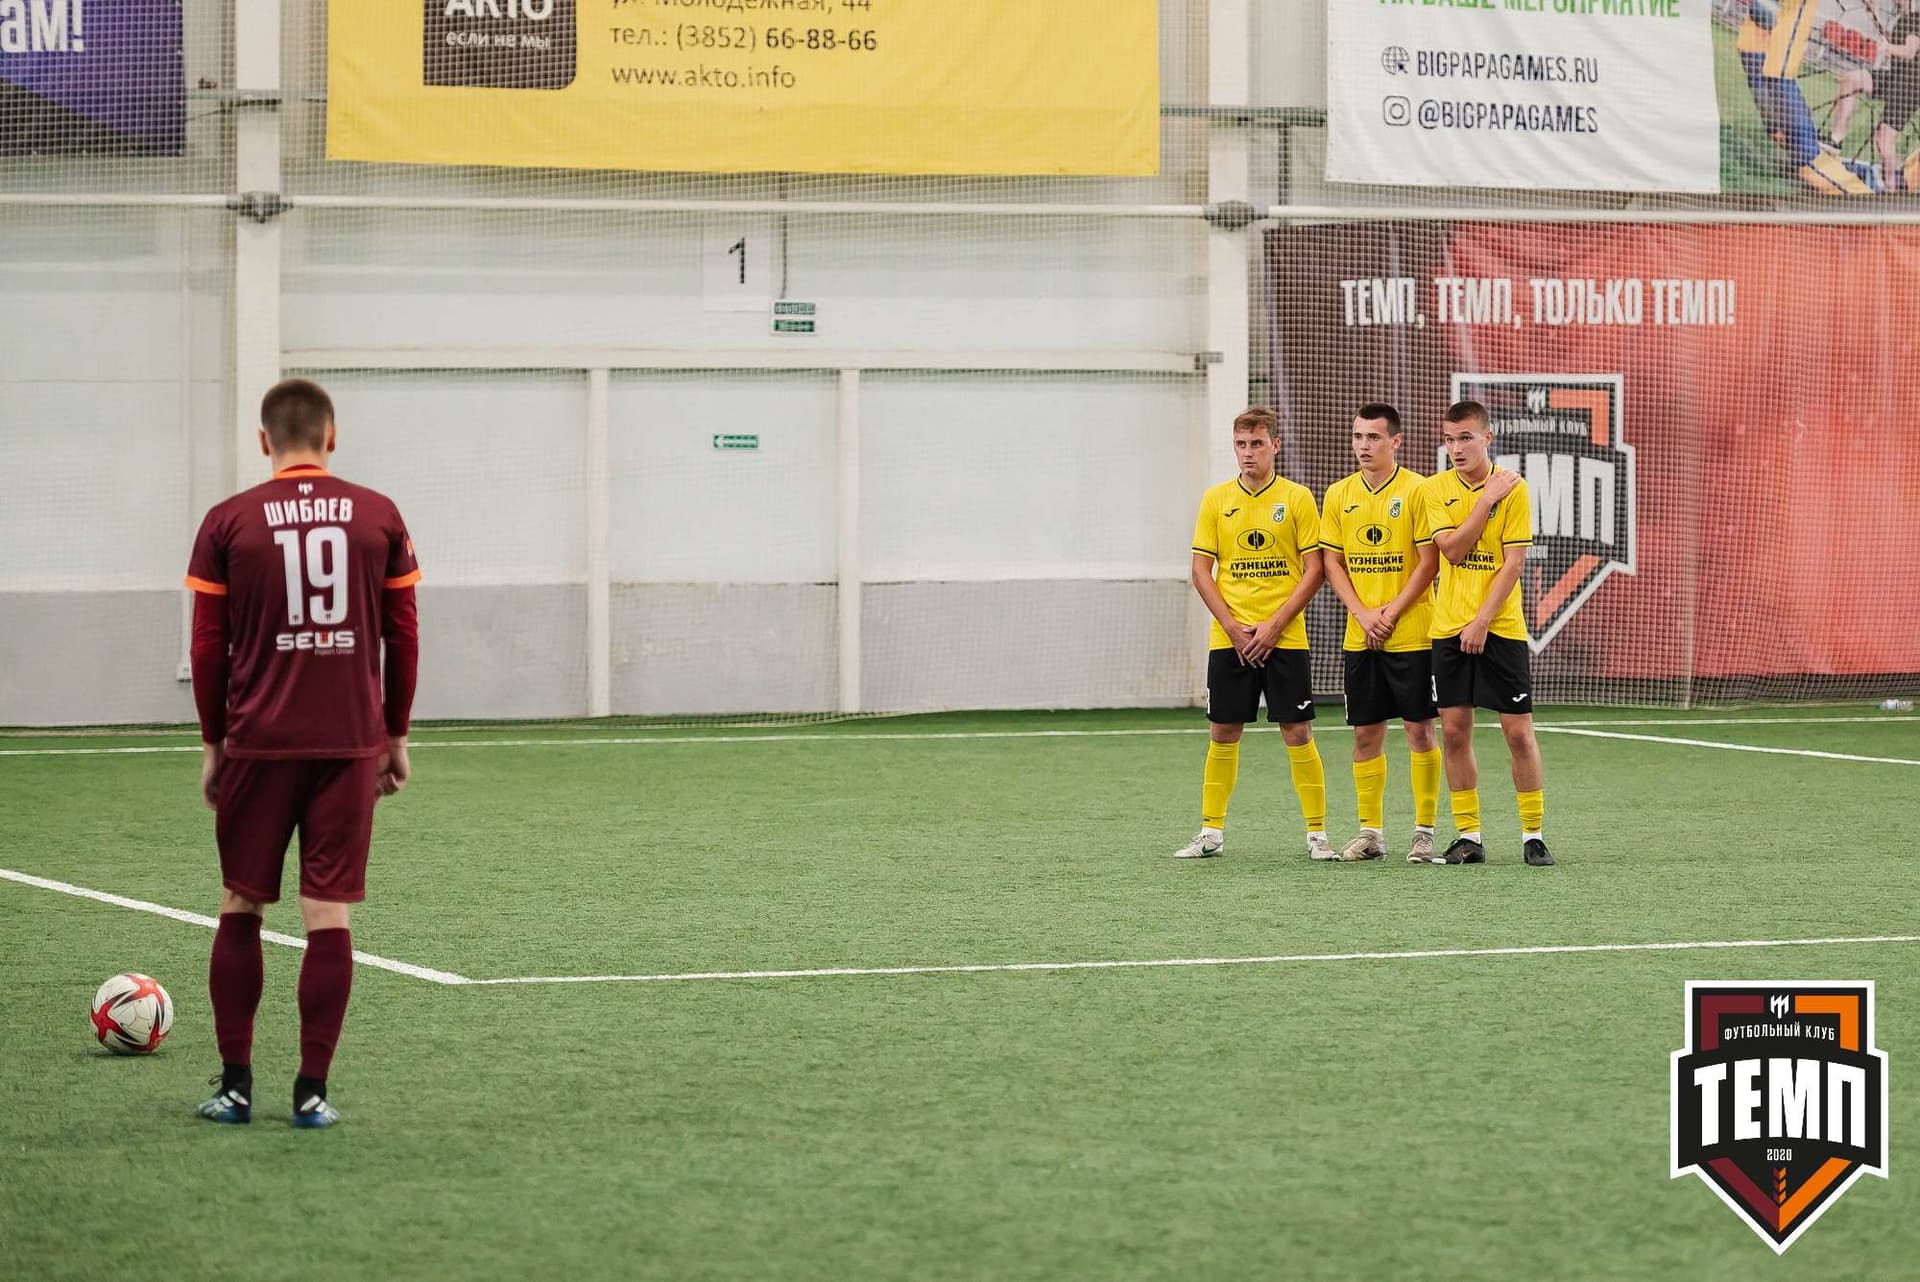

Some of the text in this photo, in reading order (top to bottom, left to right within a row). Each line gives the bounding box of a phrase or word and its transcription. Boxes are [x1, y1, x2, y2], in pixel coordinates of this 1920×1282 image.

[446, 31, 550, 49] если не мы
[610, 23, 877, 51] тел.: (3852) 66-88-66
[611, 64, 796, 89] www.akto.info
[1417, 50, 1599, 83] BIGPAPAGAMES.RU
[1418, 98, 1599, 133] @BIGPAPAGAMES
[727, 236, 746, 285] 1
[1339, 277, 1737, 330] ТЕМП, ТЕМП, ТОЛЬКО ТЕМП!
[263, 497, 354, 528] ШИБАЕВ
[273, 526, 349, 627] 19
[275, 630, 356, 652] SEUS
